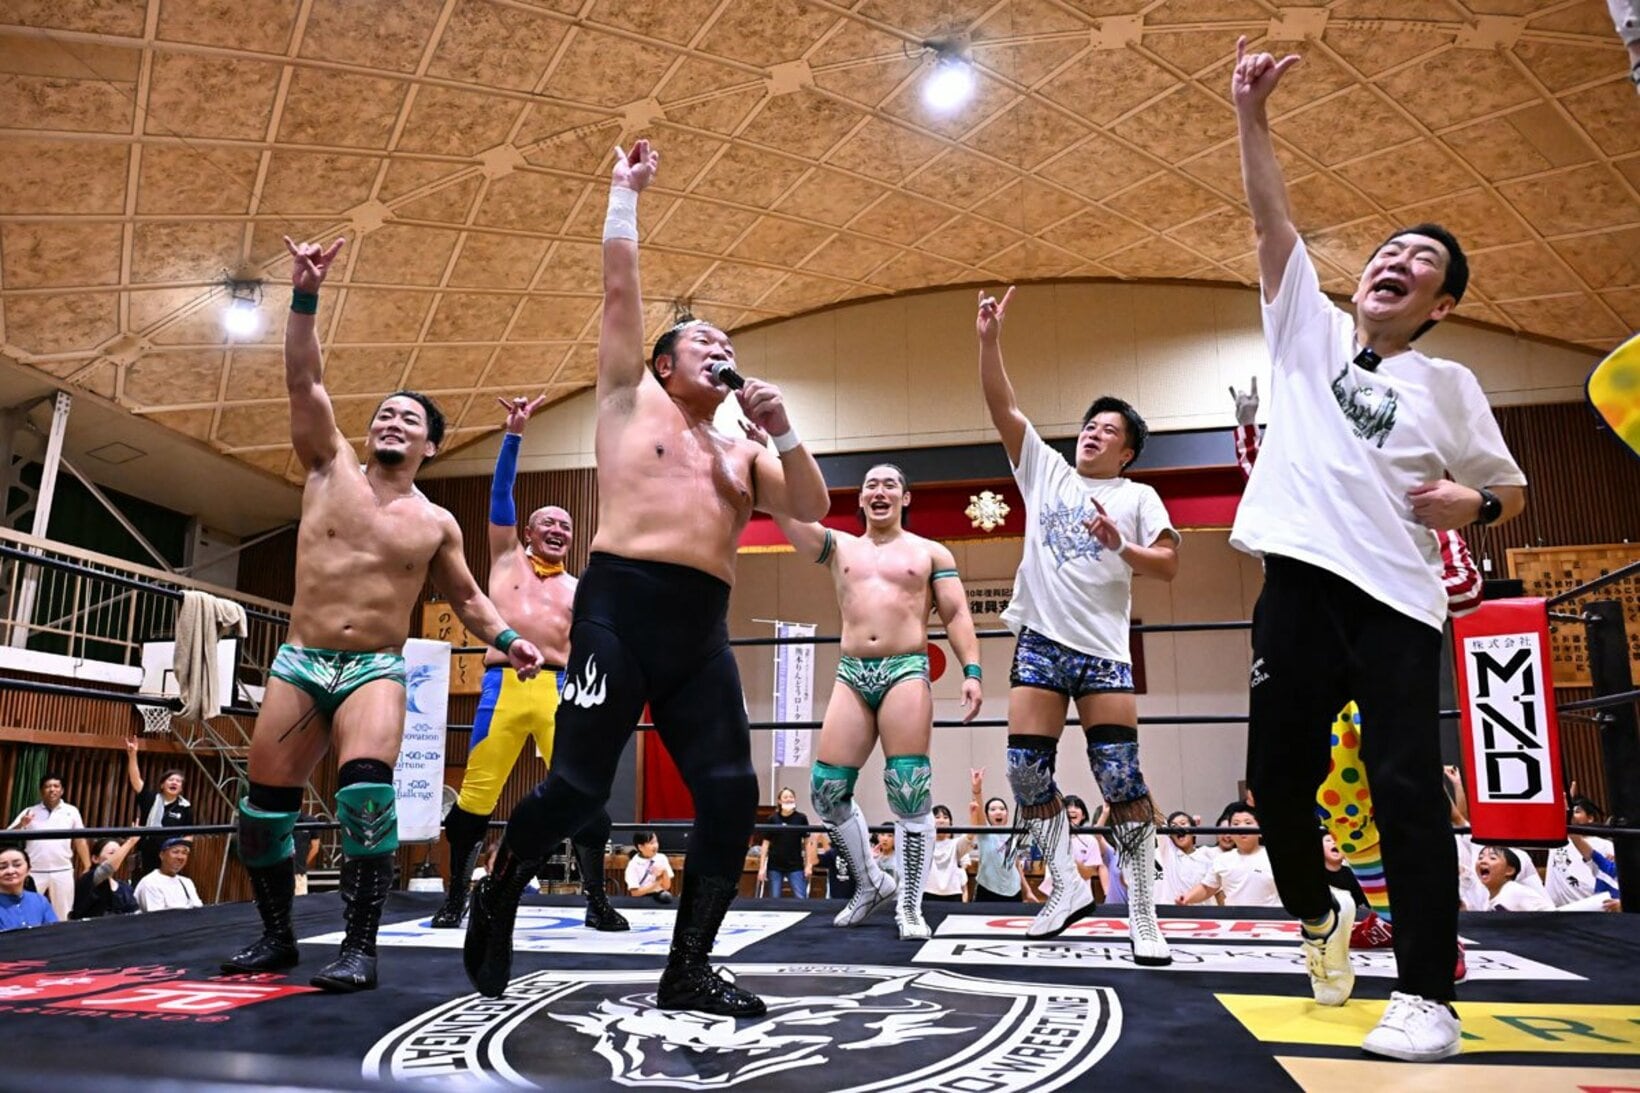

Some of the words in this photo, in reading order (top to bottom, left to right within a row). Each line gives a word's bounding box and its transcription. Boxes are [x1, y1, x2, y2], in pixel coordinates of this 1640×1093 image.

[1472, 636, 1532, 649] 株式会社
[397, 787, 434, 801] hallenge
